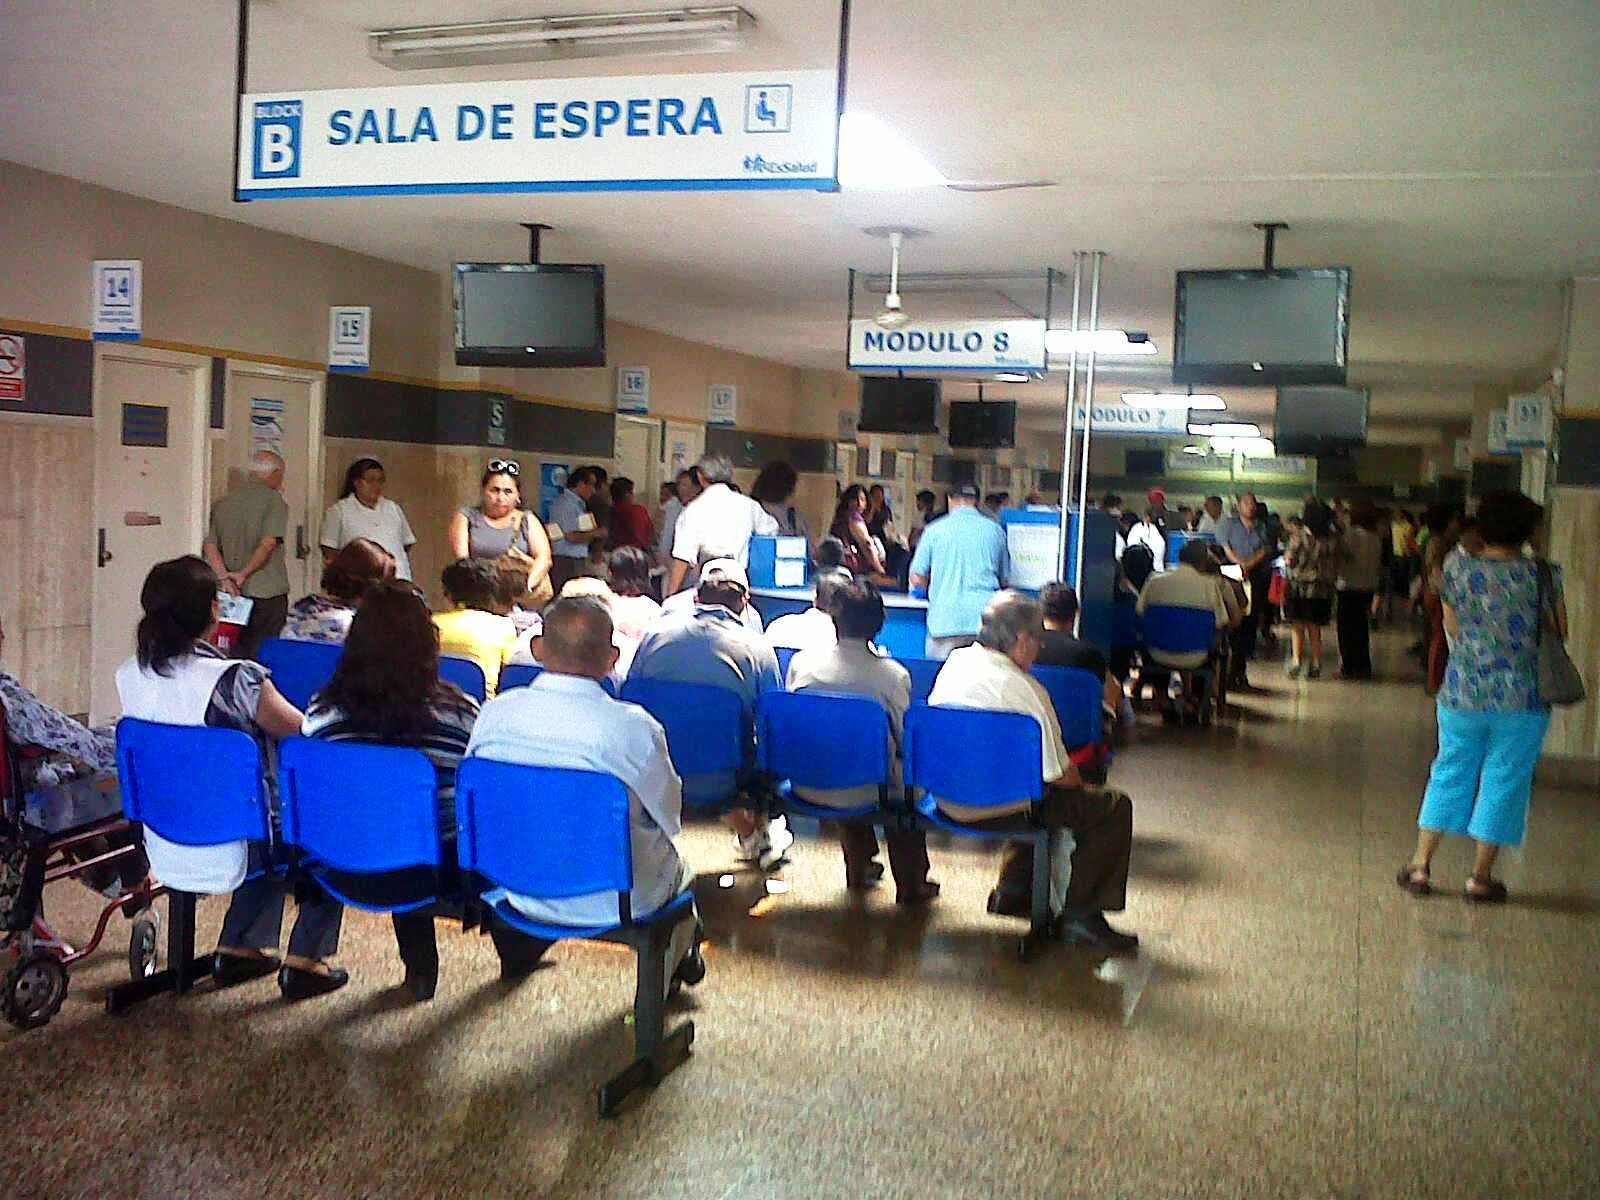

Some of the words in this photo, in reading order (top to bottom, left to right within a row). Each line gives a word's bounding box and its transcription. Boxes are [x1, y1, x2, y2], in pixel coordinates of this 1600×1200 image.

[328, 106, 438, 145] SALA
[457, 103, 514, 141] DE
[534, 97, 723, 139] ESPERA
[261, 124, 295, 173] B
[108, 277, 129, 298] 14
[342, 320, 361, 337] 15
[864, 331, 983, 352] MODULO
